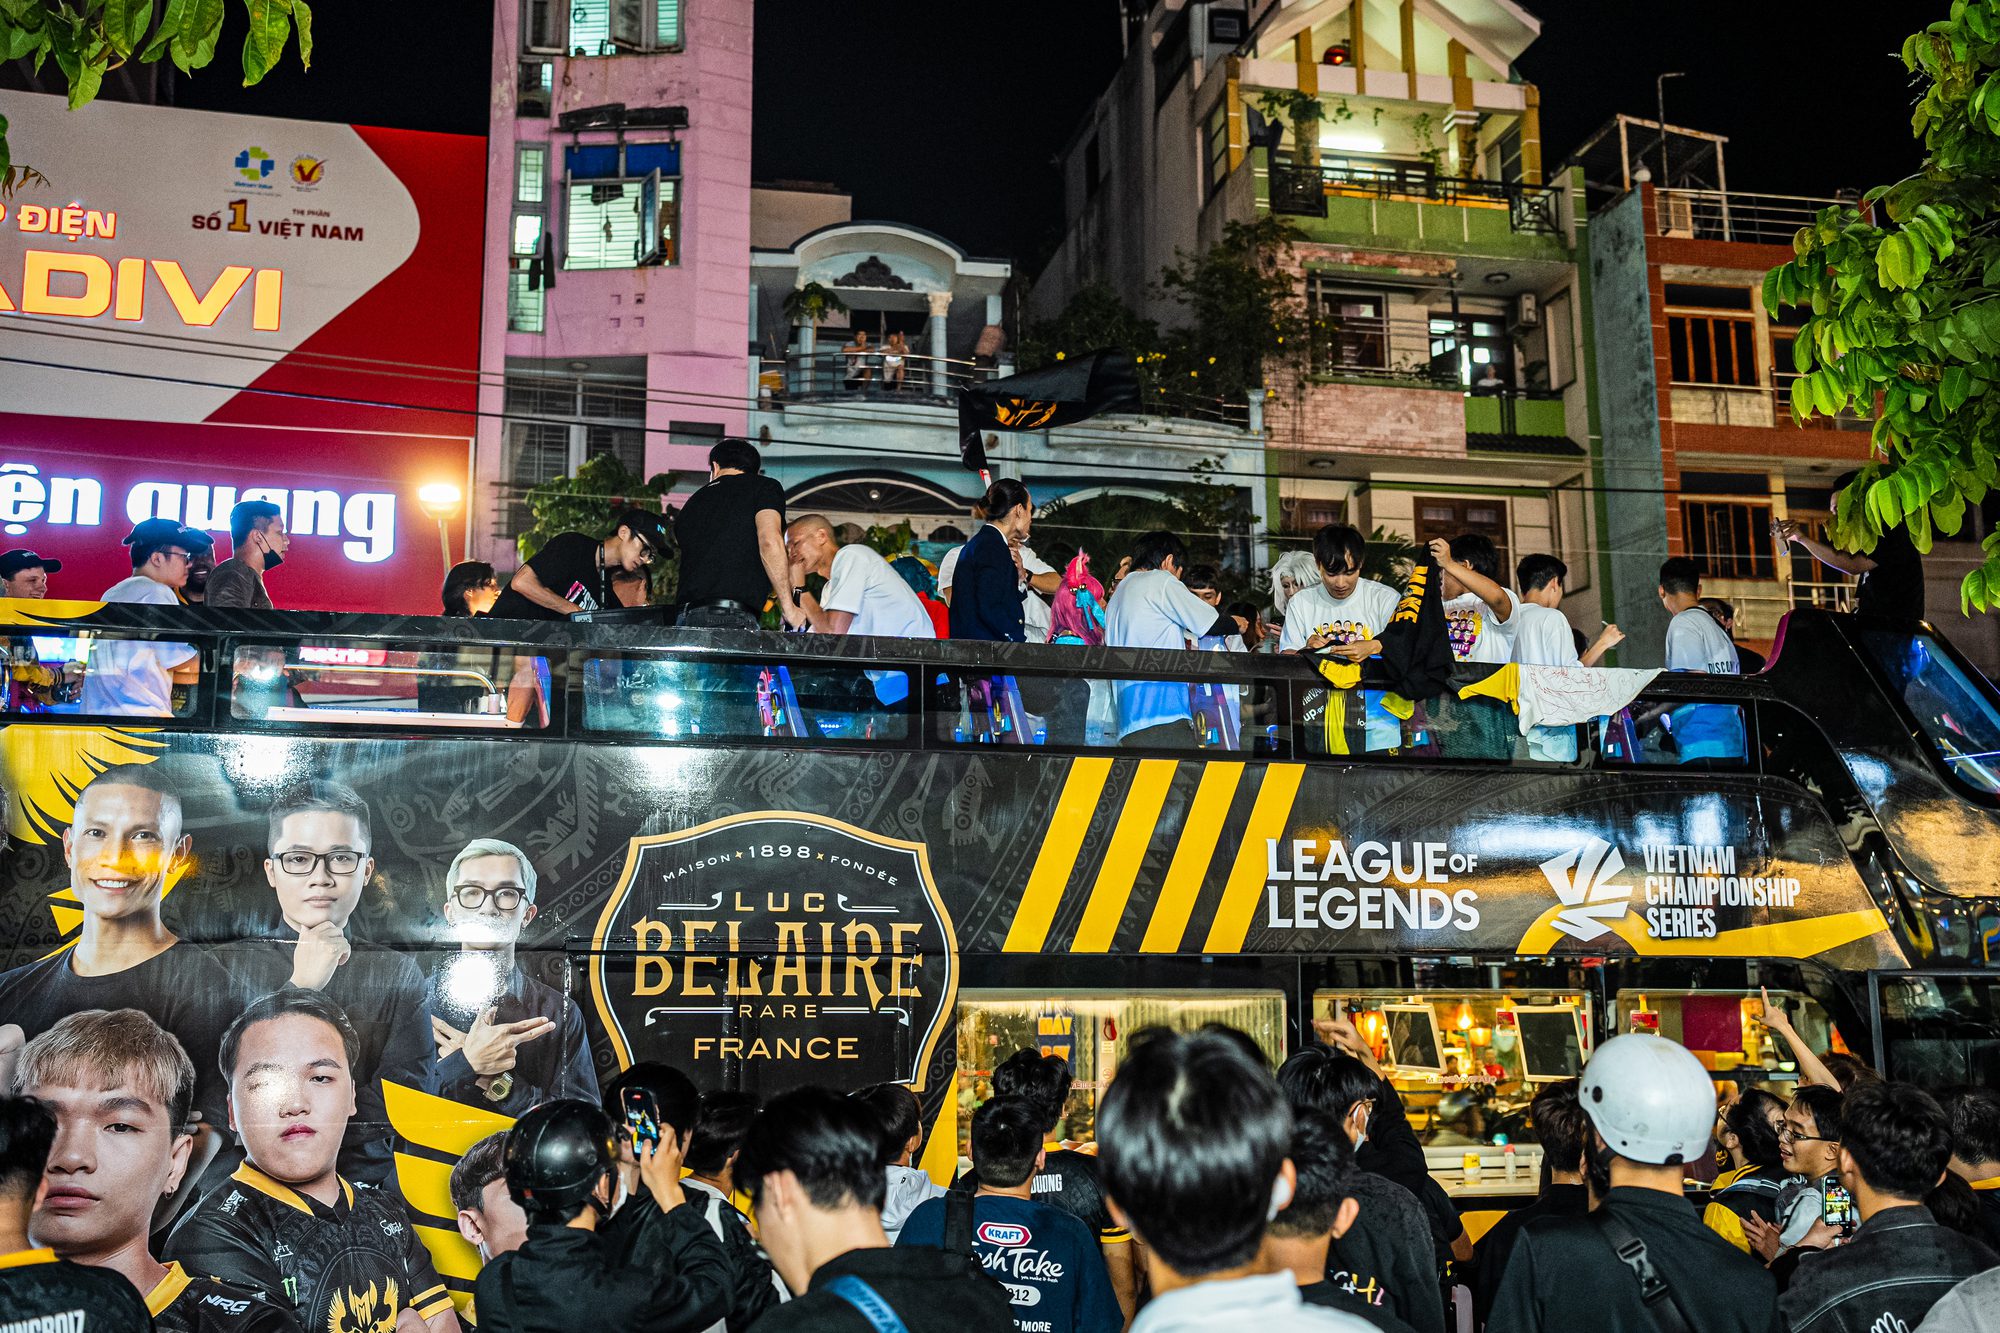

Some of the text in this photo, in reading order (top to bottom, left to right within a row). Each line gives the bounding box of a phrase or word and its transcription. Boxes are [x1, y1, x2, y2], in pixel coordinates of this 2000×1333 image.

[16, 201, 117, 242] ĐIỆN
[192, 199, 251, 233] SỐ 1
[258, 218, 364, 242] VIỆT NAM
[0, 249, 283, 332] DIVI
[127, 482, 396, 563] quang
[663, 844, 898, 886] MAISON 1898 FONDÉE
[1266, 838, 1478, 883] LEAGUE OF
[1643, 844, 1736, 874] VIETNAM
[735, 892, 825, 912] LUC
[1645, 876, 1801, 907] CHAMPIONSHIP
[1267, 885, 1480, 931] LEGENDS
[1646, 908, 1717, 938] SERIES
[631, 915, 923, 1010] BELAIRE
[739, 1004, 818, 1019] RARE
[693, 1037, 859, 1060] FRANCE
[988, 1228, 1022, 1240] KRAFT
[1007, 1248, 1064, 1278] Take
[199, 1294, 251, 1312] NRG
[1021, 1320, 1052, 1333] MORE
